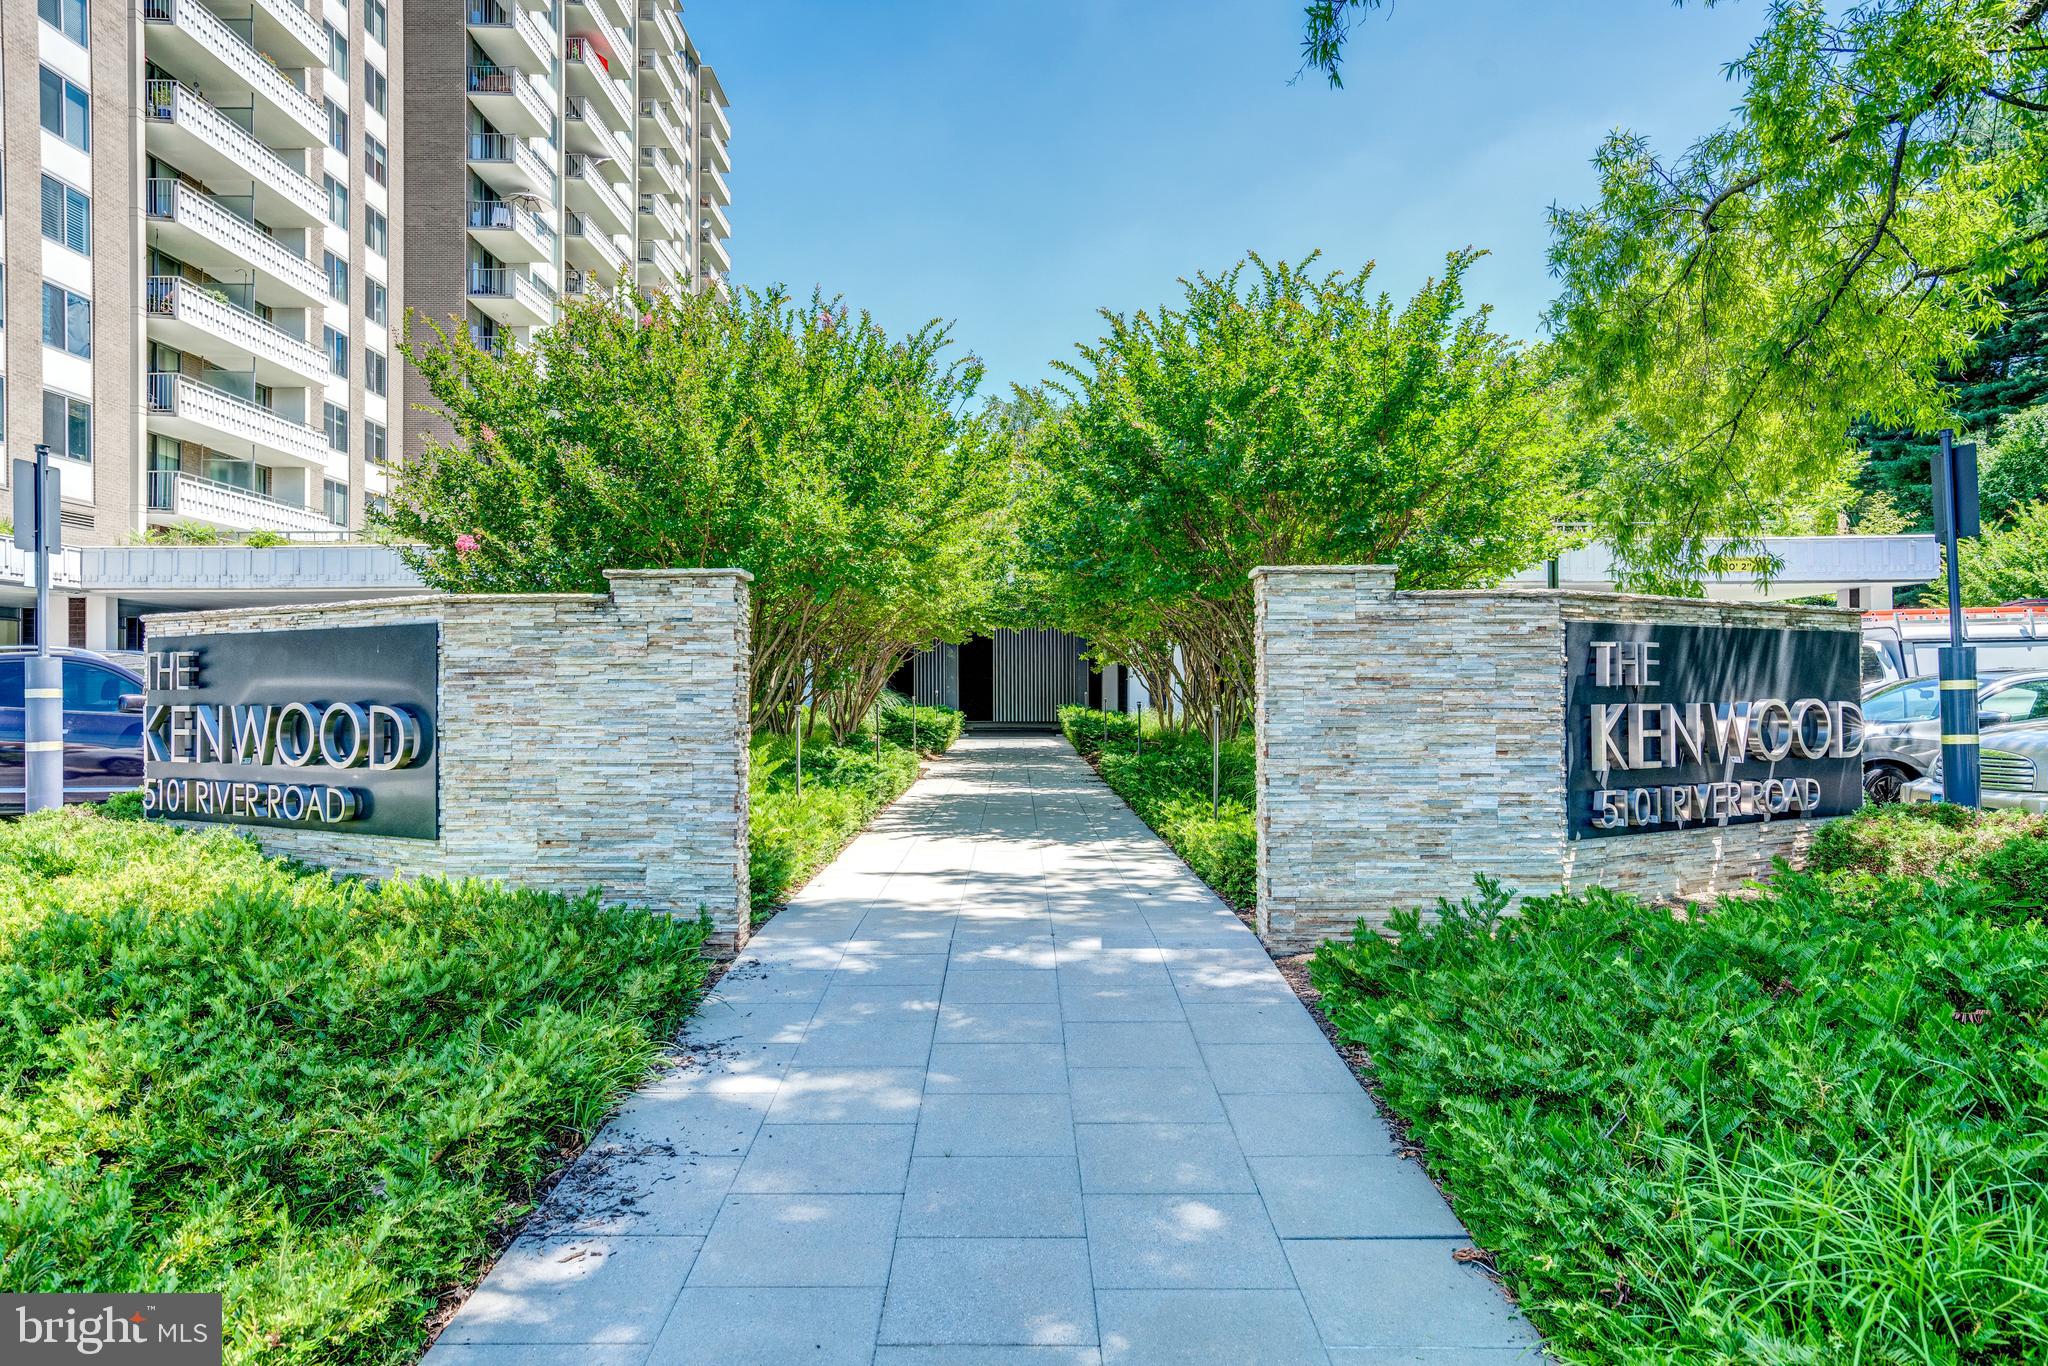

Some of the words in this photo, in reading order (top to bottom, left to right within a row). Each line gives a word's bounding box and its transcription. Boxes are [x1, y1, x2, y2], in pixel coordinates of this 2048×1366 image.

[146, 651, 199, 691] THE
[1590, 640, 1660, 687] THE
[143, 701, 412, 771] KENWOOD
[1591, 698, 1864, 771] KENWOOD
[142, 778, 188, 814] 5101
[196, 781, 258, 818] RIVER
[267, 784, 352, 824] ROAD
[1592, 788, 1662, 829] 5101
[1664, 781, 1741, 824] RIVER
[1742, 778, 1821, 815] ROAD
